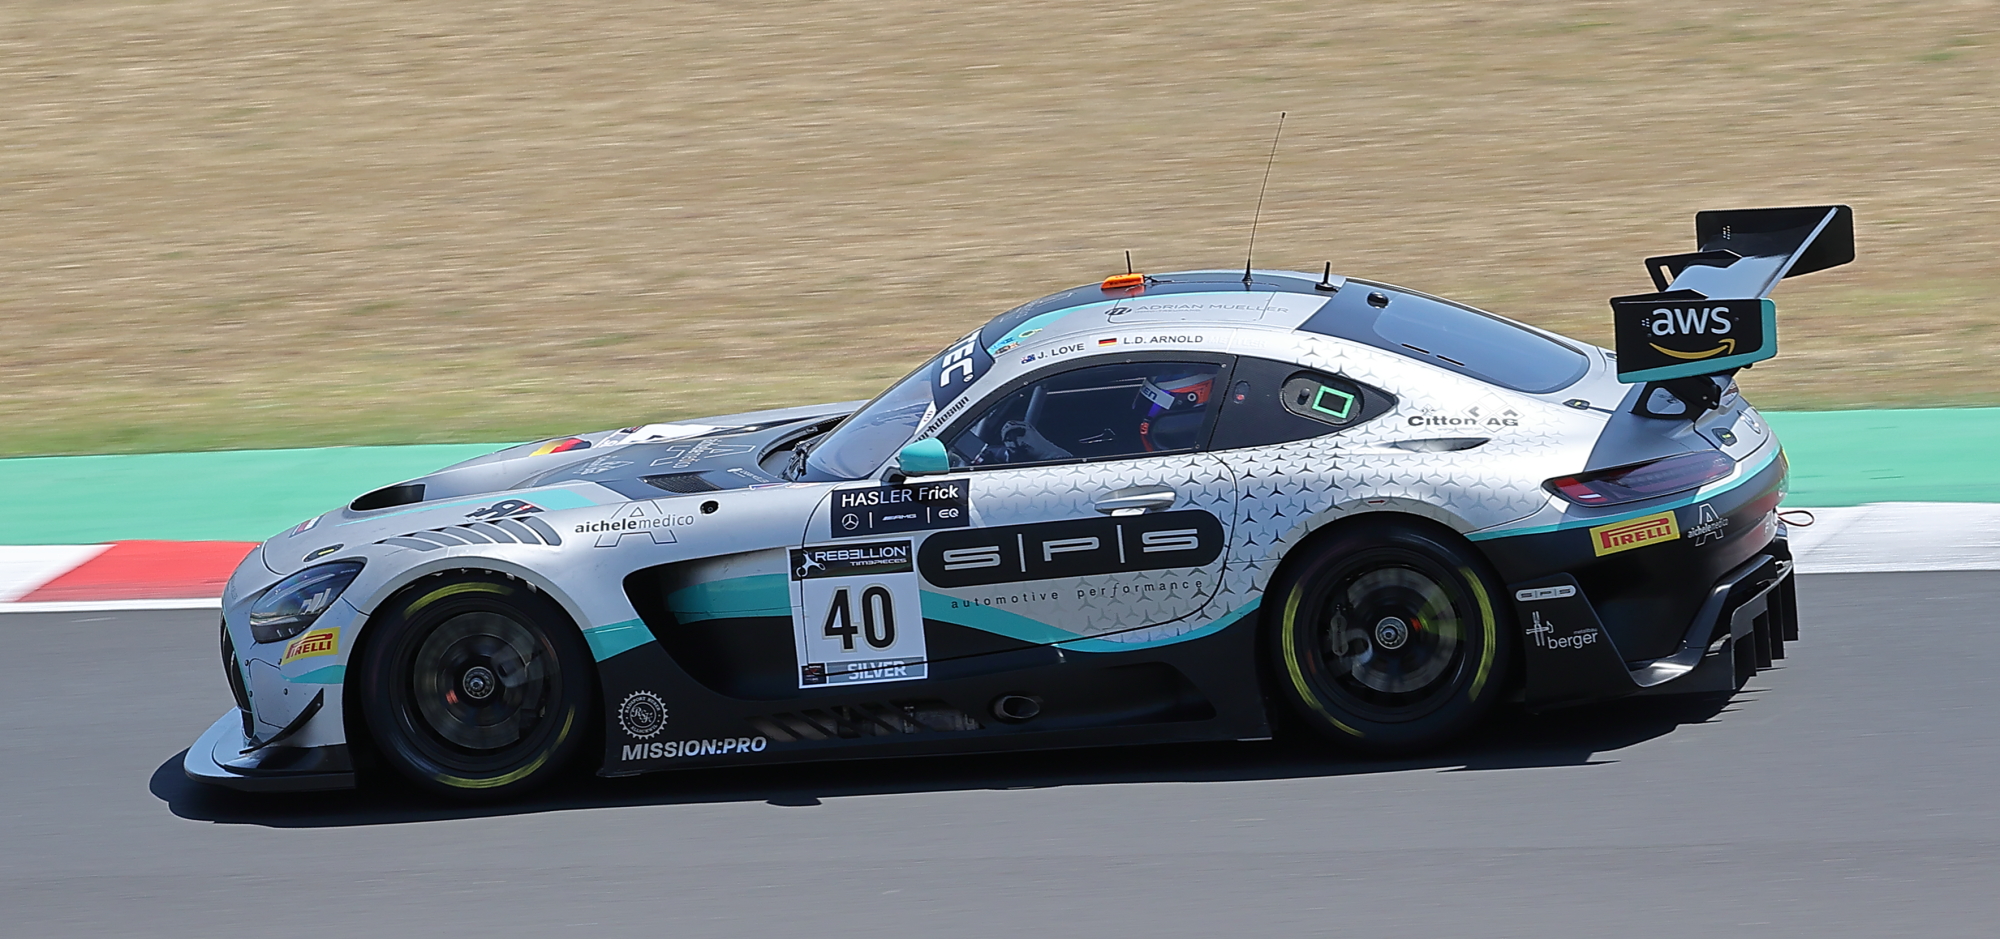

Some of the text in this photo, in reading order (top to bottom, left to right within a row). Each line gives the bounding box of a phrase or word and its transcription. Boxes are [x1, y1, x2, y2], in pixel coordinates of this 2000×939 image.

[1136, 303, 1204, 312] ADRIAN
[1208, 303, 1289, 313] MUELLER
[1652, 307, 1732, 336] aws
[1123, 335, 1203, 345] L.D. ARNOLD
[1037, 343, 1085, 360] J. LOVE
[1407, 415, 1519, 427] Citton AG
[842, 484, 959, 508] HASLER Frick
[938, 508, 959, 519] EQ
[575, 514, 694, 534] aichelemedico
[1600, 517, 1672, 549] PIRELLI
[815, 545, 906, 562] REBELLION
[951, 579, 1203, 609] automotive performance
[823, 585, 896, 650] 40
[286, 633, 334, 660] PIRELLI
[1547, 632, 1598, 649] berger
[847, 660, 907, 680] SILVER
[621, 736, 767, 761] MISSION:PRO
